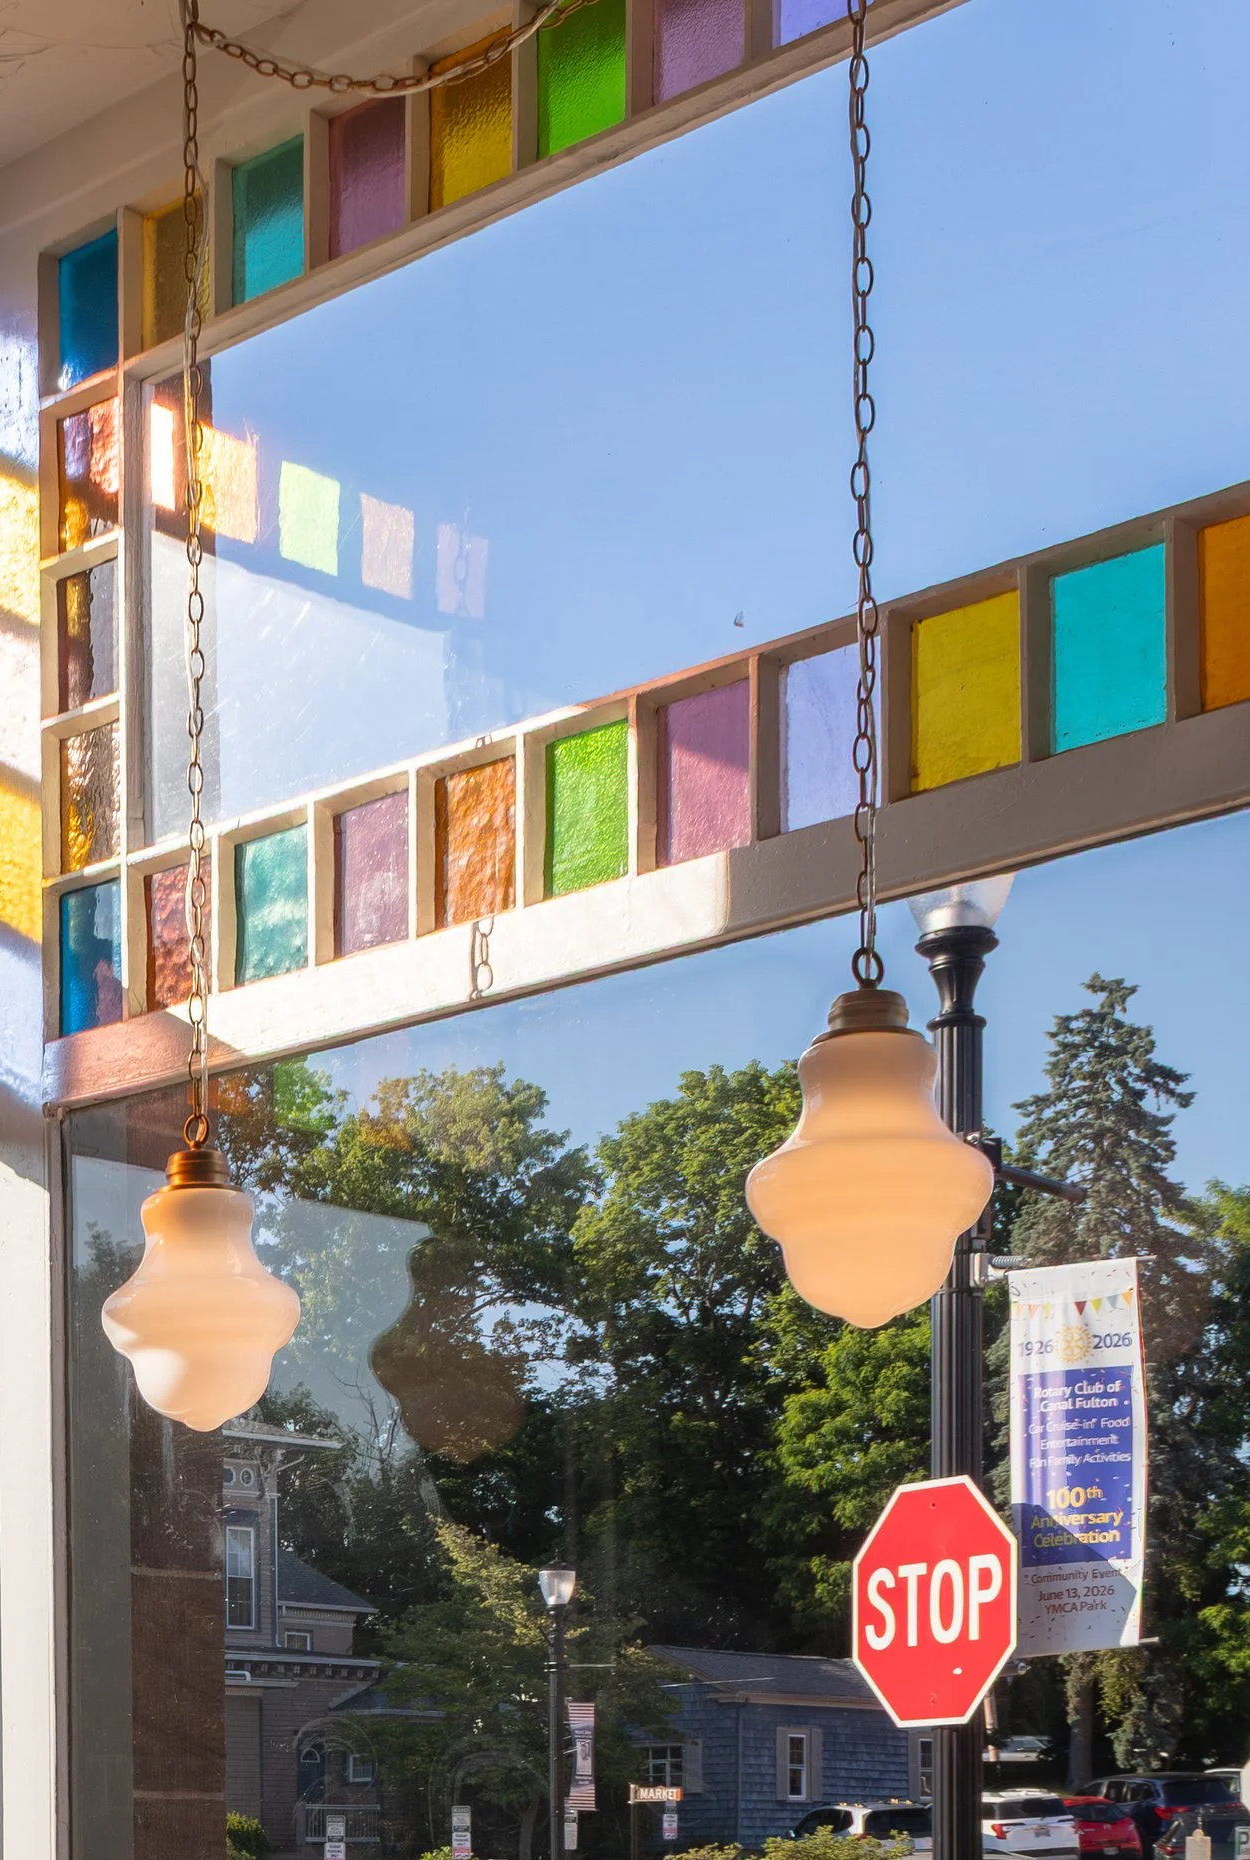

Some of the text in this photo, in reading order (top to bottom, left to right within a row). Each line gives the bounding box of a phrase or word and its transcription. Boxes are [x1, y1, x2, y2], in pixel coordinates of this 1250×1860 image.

[1018, 1332, 1133, 1357] 1926 2026
[1034, 1380, 1122, 1399] Rotary Club of
[1040, 1397, 1118, 1412] Canal Fulton
[1028, 1423, 1045, 1434] Car
[1100, 1416, 1131, 1428] Food
[1040, 1434, 1119, 1450] Entertainment
[1029, 1452, 1132, 1468] Fun Family Activities
[1046, 1485, 1104, 1510] 100th
[1030, 1510, 1124, 1529] Anniversary
[1033, 1529, 1121, 1548] Celebration
[1031, 1569, 1089, 1584] Community
[1038, 1585, 1115, 1602] June 13, 2026
[865, 1554, 1003, 1652] STOP
[1044, 1600, 1107, 1615] YMCA Park
[639, 1788, 677, 1800] MARKET
